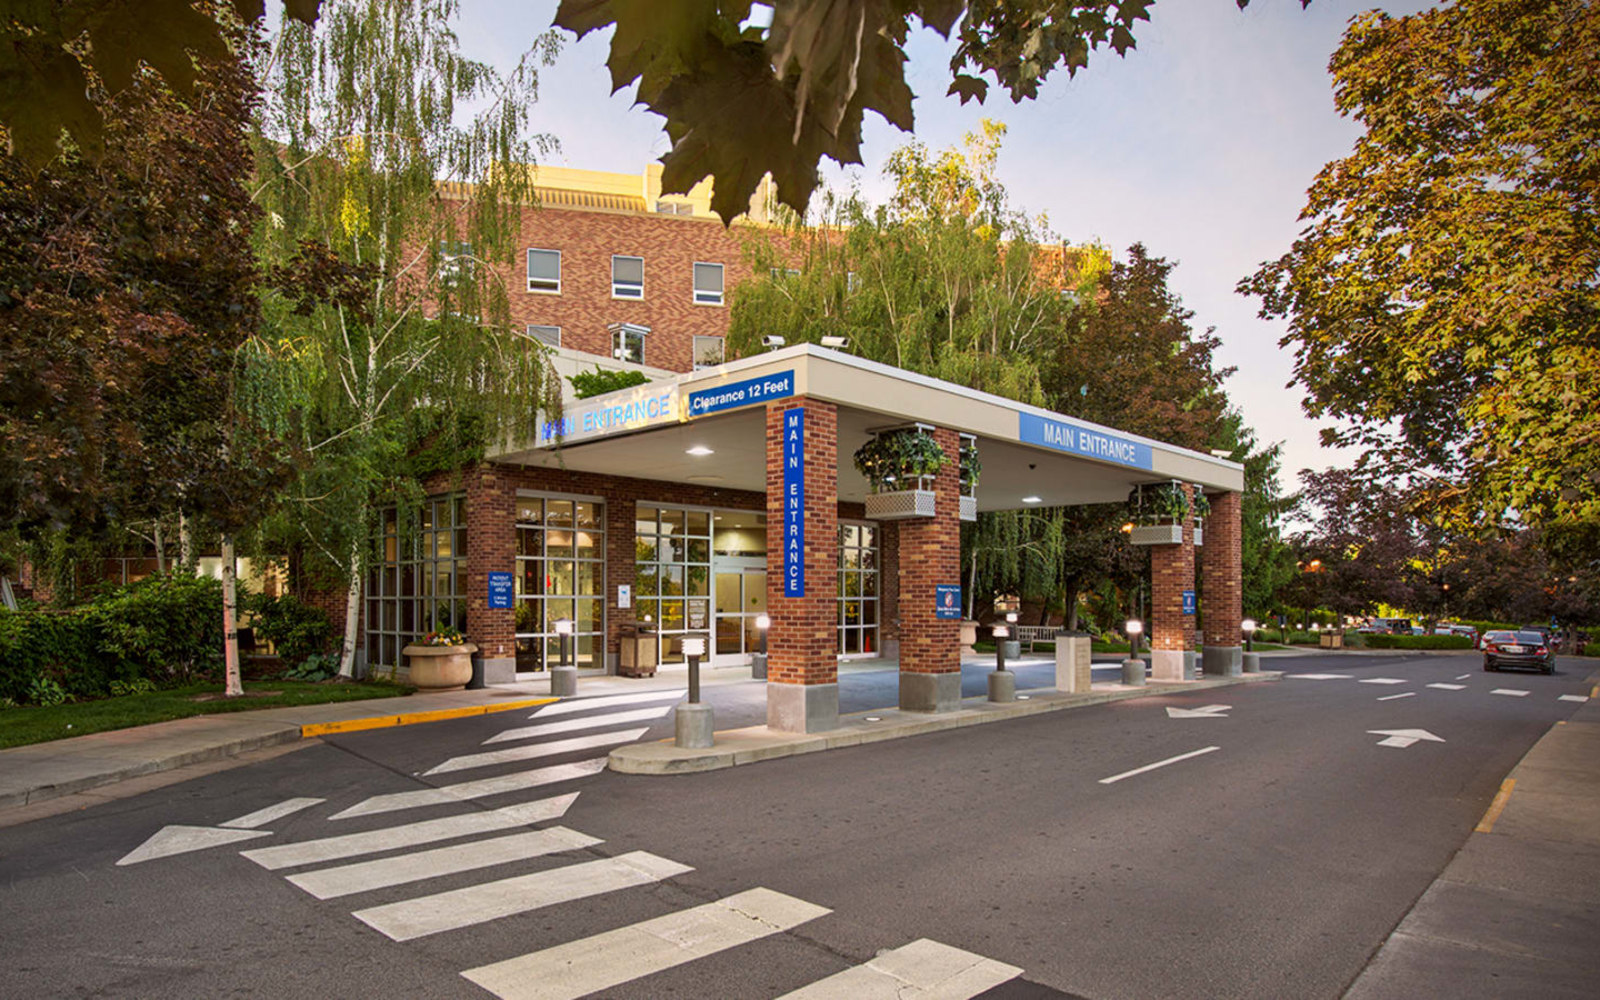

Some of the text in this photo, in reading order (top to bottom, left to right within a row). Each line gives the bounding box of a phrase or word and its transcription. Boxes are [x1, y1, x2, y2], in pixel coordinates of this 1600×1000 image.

[693, 378, 789, 409] Clearance 12 Feet
[583, 394, 670, 432] ENTRANCE
[1044, 423, 1136, 462] MAIN ENTRANCE
[789, 415, 798, 591] MAIN ENTRANCE
